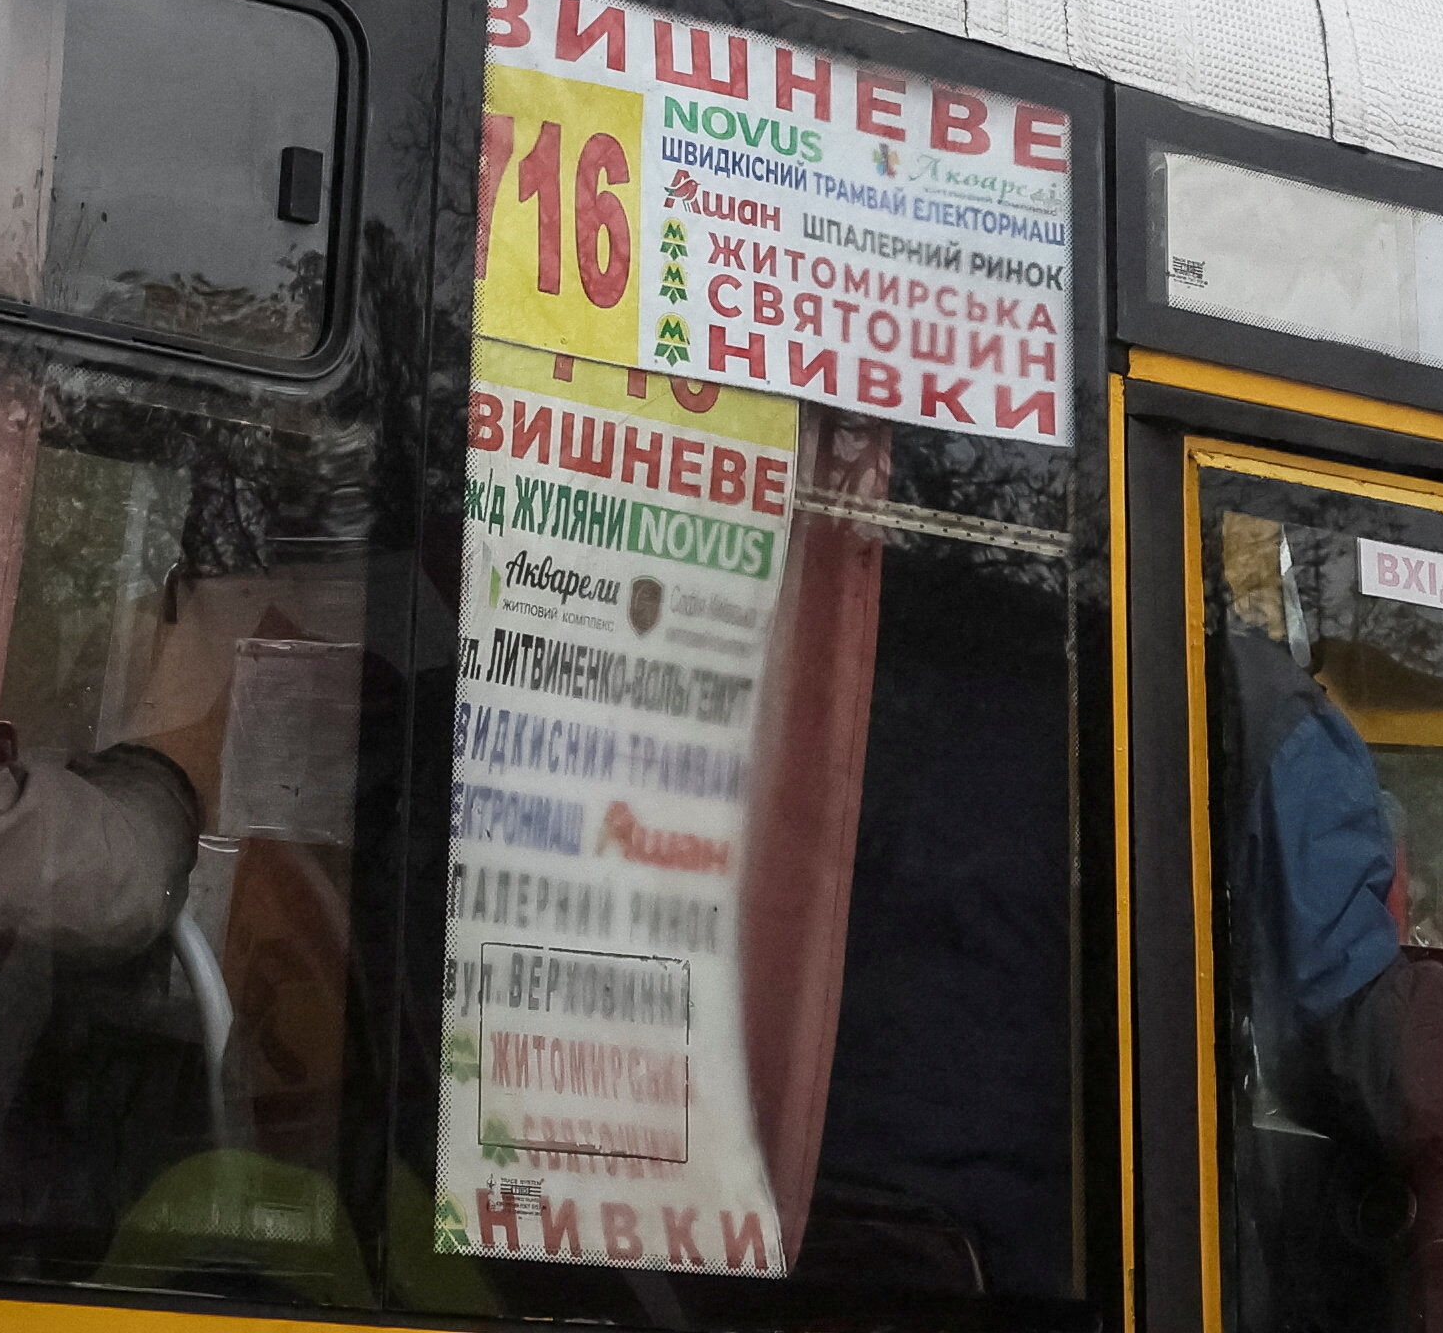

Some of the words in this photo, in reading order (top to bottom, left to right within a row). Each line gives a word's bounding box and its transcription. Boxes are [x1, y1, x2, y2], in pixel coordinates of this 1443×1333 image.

[663, 95, 823, 163] NOVUS
[661, 135, 807, 191] ШВИДКІСНИЙ
[812, 171, 906, 219] ТРАМВАЙ
[706, 231, 1058, 335] ЖИТОМИРСЬКА
[802, 211, 963, 274] ШПАЛЕРНИЙ
[968, 252, 1065, 293] РИНОК
[707, 274, 1058, 382] СВЯТОШИН
[706, 324, 1057, 436] НИВКИ
[469, 390, 789, 517] ВИШНЕВЕ
[512, 474, 628, 552] ЖУЛЯНИ
[637, 505, 764, 576] NOVUS
[505, 549, 622, 606] Акварели
[475, 1187, 769, 1271] НИВКИ
